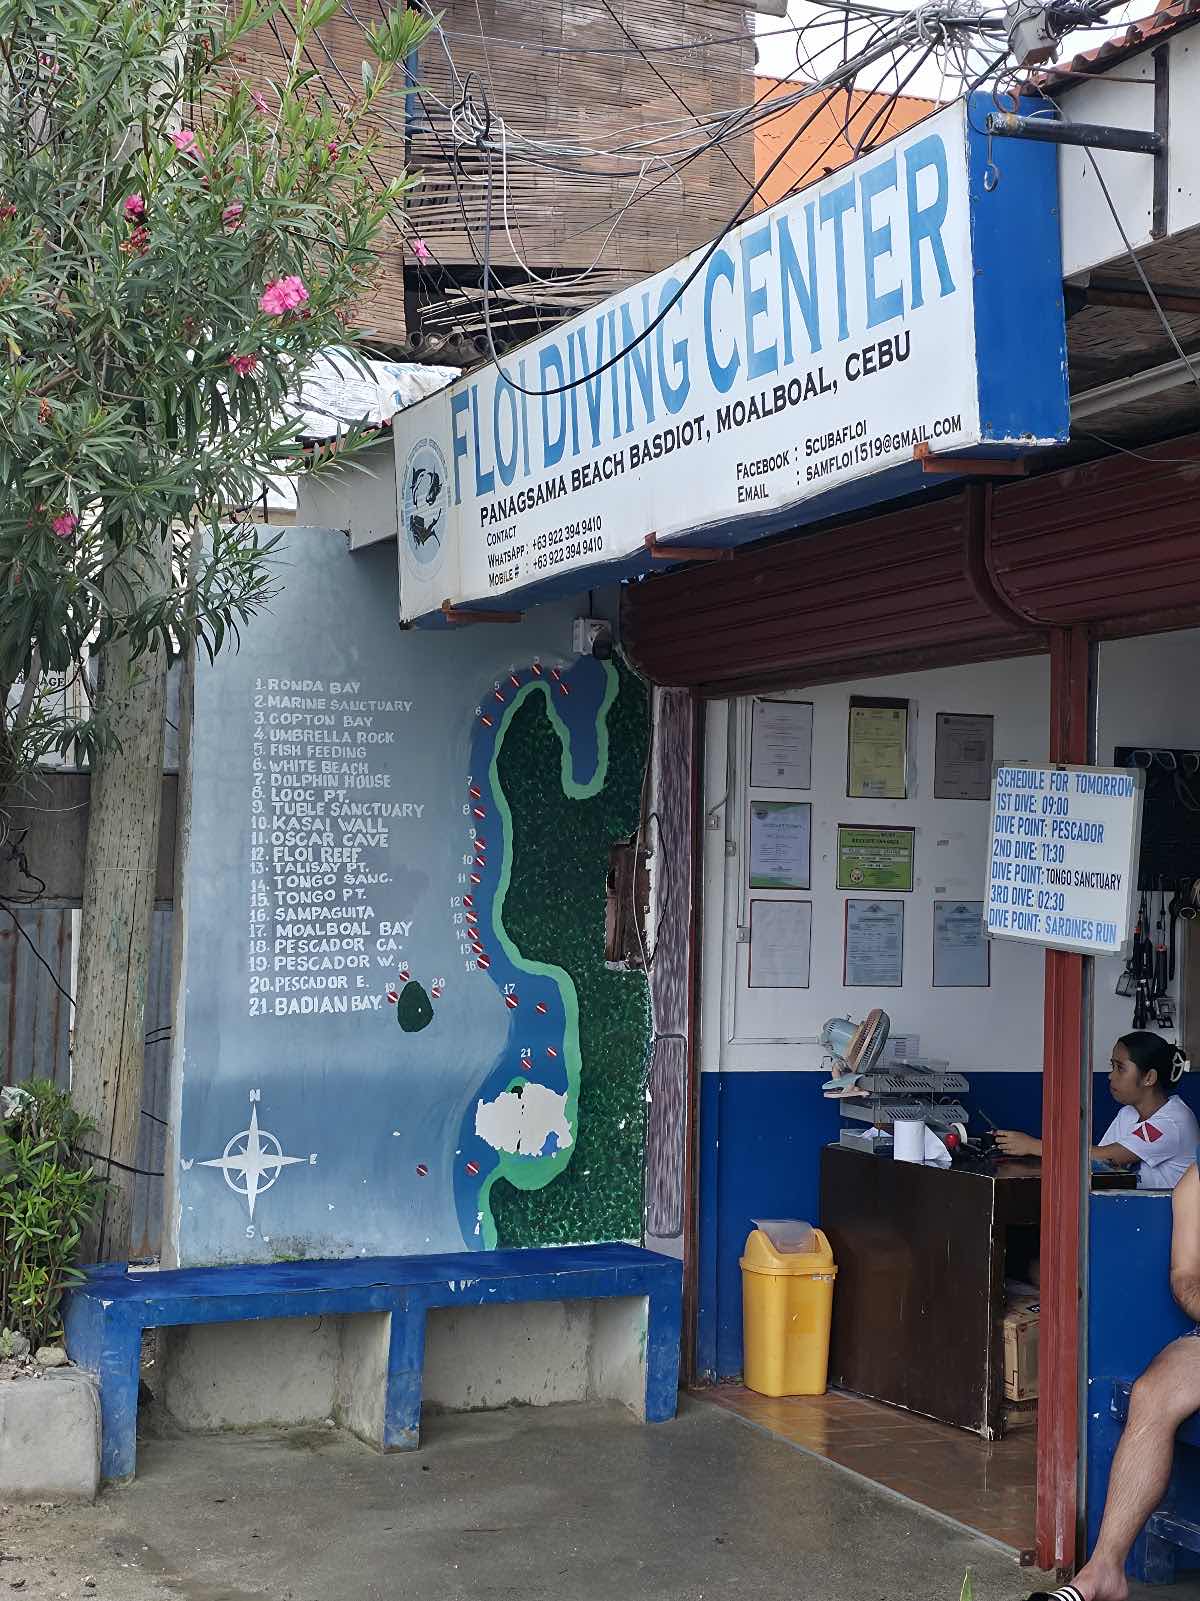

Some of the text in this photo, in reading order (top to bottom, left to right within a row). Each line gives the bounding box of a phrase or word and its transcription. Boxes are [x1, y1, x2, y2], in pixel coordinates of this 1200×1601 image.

[450, 359, 531, 505] FLOI
[538, 277, 690, 469] DIVING
[703, 133, 956, 393] CENTER
[480, 474, 568, 528] PANAGSAMA
[571, 453, 625, 492] BEACH
[630, 415, 711, 469] BASDIOT,
[717, 367, 838, 433] MOALBOAL,
[845, 330, 911, 382] CEBU
[737, 450, 790, 480] FACEBOOK
[805, 420, 867, 457] SCUBAFLOI
[737, 483, 769, 503] EMAIL
[806, 414, 962, 482] SAMFLOI1519@GMAIL.COM
[486, 526, 517, 546] CONTACT
[532, 534, 547, 551] +63
[548, 528, 564, 546] 922
[564, 522, 580, 540] 394
[582, 515, 602, 535] 9410
[488, 567, 514, 588] MOBILE
[533, 554, 548, 570] +63
[549, 548, 564, 565] 922
[566, 542, 580, 560] 394
[582, 536, 603, 555] 9410
[329, 682, 360, 694] BAY
[330, 699, 413, 712] SANCTUARY
[343, 716, 374, 728] BAY
[270, 728, 352, 743] UMBRELLA
[356, 731, 396, 744] ROCK
[270, 744, 301, 757] FISH
[307, 746, 367, 759] FEEDING
[269, 759, 317, 773] WHITE
[322, 760, 368, 775] BEACH
[270, 773, 339, 787] DOLPHIN
[344, 774, 392, 789] HOUSE
[466, 776, 473, 786] 7
[997, 769, 1134, 798] SCHEDULE FOR TOMORROW
[271, 787, 316, 802] LOOC
[272, 802, 326, 817] TUBLE
[330, 802, 425, 818] SANCTUARY
[462, 804, 470, 816] 8
[996, 793, 1069, 816] 1ST DIVE: 09:00
[272, 816, 331, 832] KASAI
[337, 818, 388, 834] WALL
[994, 814, 1105, 844] DIVE POINT: PESCADOR
[271, 832, 335, 847] OSCAR
[342, 833, 388, 848] CAVE
[468, 828, 476, 840] 9
[273, 846, 313, 862] FLOI
[320, 847, 363, 863] REEF
[994, 838, 1065, 864] 2ND DIVE: 11:30
[462, 854, 473, 865] 10
[273, 862, 341, 874] TALISAY
[992, 860, 1122, 891] DIVE POINT: TONGO SANCTUARY
[274, 874, 337, 890] TONGO
[457, 873, 466, 883] 11
[274, 889, 336, 906] TONGO
[450, 896, 461, 907] 12
[990, 884, 1065, 912] 3RD DIVE: 02:30
[274, 906, 375, 922] SAMPAGUITA
[454, 914, 463, 924] 13
[276, 922, 372, 938] MOALBOAL
[379, 921, 413, 937] BAY
[988, 908, 1009, 929] DIVE
[1012, 912, 1041, 933] POINT:
[1044, 916, 1093, 940] SARDINES
[1096, 922, 1117, 945] RUN
[456, 930, 466, 940] 14
[274, 938, 365, 954] PESCADOR
[460, 943, 471, 954] 15
[274, 954, 370, 972] PESCADOR
[398, 961, 409, 972] 18
[464, 960, 476, 972] 16
[384, 982, 396, 993] 19
[432, 978, 446, 988] 20
[504, 984, 516, 995] 17
[520, 1048, 531, 1058] 21
[249, 1088, 261, 1102] N
[180, 1158, 194, 1170] W
[309, 1153, 318, 1165] E
[246, 1225, 255, 1238] S
